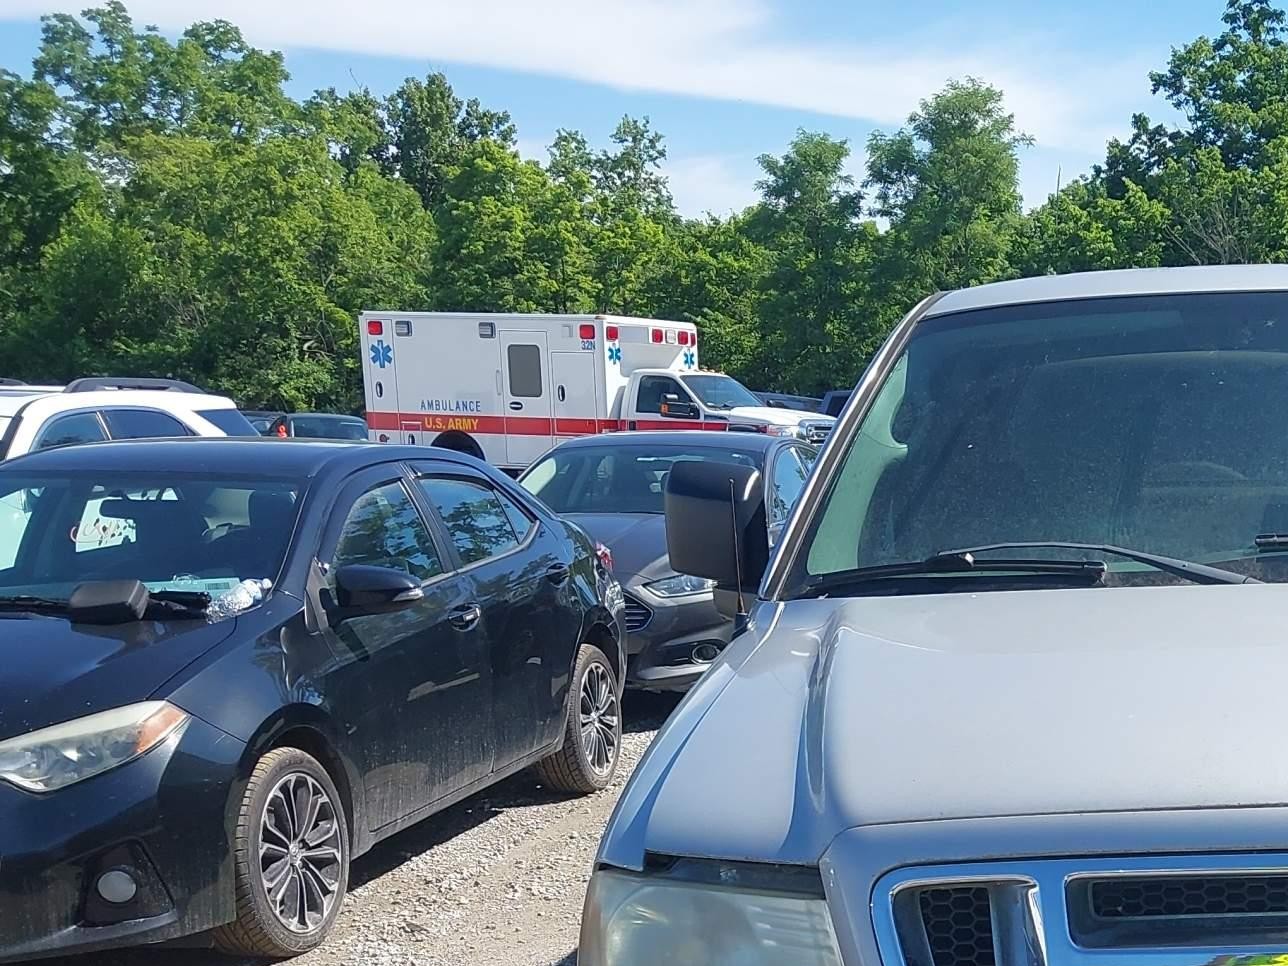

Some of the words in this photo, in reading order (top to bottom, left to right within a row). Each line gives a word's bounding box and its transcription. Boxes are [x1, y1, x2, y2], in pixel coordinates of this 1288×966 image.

[420, 399, 481, 412] AMBULANCE
[424, 416, 446, 429] U.S.
[447, 417, 479, 431] ARMY
